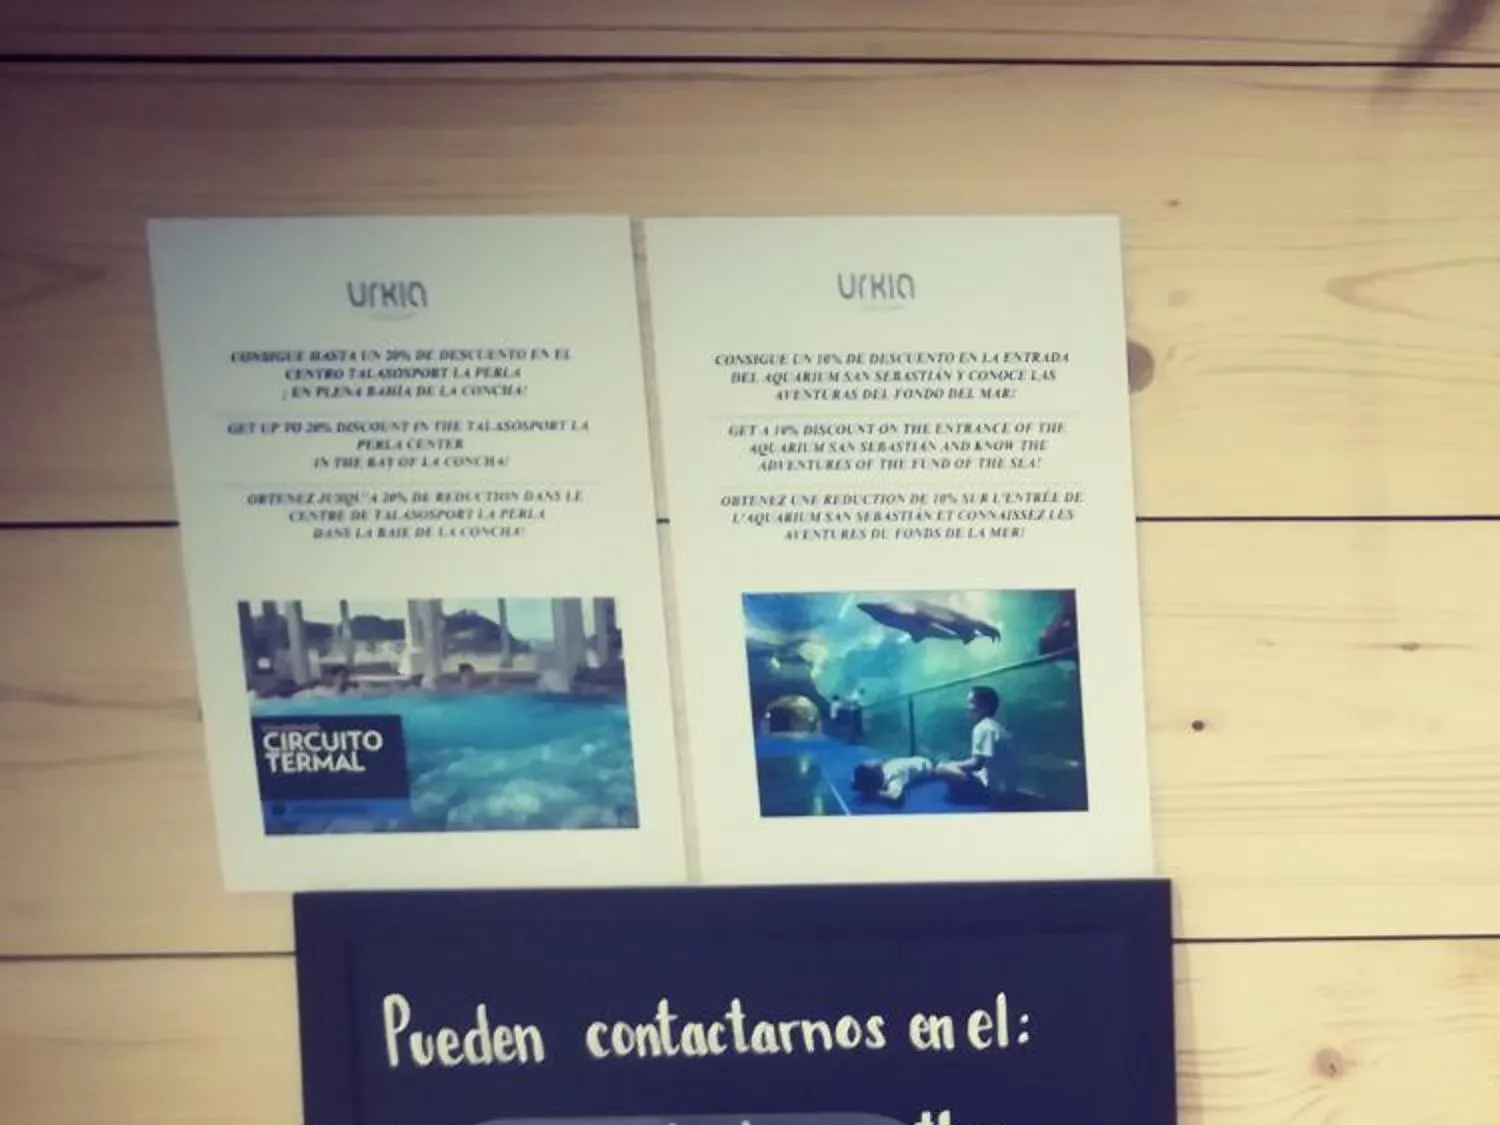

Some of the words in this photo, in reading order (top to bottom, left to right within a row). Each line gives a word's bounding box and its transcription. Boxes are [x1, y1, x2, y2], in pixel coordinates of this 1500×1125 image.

[361, 350, 381, 362] UN
[415, 350, 432, 361] DE
[439, 349, 527, 361] DESCUENTO
[530, 349, 549, 361] EN
[715, 353, 786, 365] CONSIGUE
[792, 353, 812, 365] UN
[817, 353, 842, 365] 10%
[846, 353, 863, 364] DE
[869, 352, 955, 364] DESCUENTO
[959, 352, 977, 363] EN
[981, 352, 999, 363] LA
[1003, 351, 1070, 363] ENTRADA
[284, 368, 345, 380] CENTRO
[453, 367, 471, 379] LA
[475, 367, 522, 379] PERLA
[731, 371, 757, 384] DEL
[765, 371, 839, 386] AQUARIUM
[843, 371, 870, 382] SAN
[967, 369, 1025, 381] CONOCE
[1030, 369, 1057, 381] LAS
[315, 386, 362, 398] PLENA
[416, 386, 434, 398] DE
[439, 385, 457, 397] LA
[776, 388, 858, 401] AVENTURAS
[862, 388, 888, 400] DEL
[894, 388, 945, 400] FONDO
[948, 387, 974, 399] DEL
[227, 422, 256, 434] GET
[261, 422, 280, 434] UP
[284, 421, 303, 433] TO
[336, 420, 409, 433] DISCOUNT
[413, 420, 430, 432] IN
[434, 420, 460, 432] THE
[571, 419, 590, 432] LA
[728, 424, 756, 436] GET
[803, 423, 873, 436] DISCOUNT
[878, 423, 898, 435] ON
[903, 422, 930, 435] THE
[935, 422, 1008, 434] ENTRANCE
[1014, 421, 1032, 434] OF
[1038, 421, 1065, 434] THE
[356, 439, 403, 451] PERLA
[406, 438, 464, 450] CENTER
[751, 441, 825, 457] AQUARIUM
[829, 440, 855, 452] SAN
[943, 439, 971, 451] AND
[974, 439, 1014, 451] KNOW
[1020, 439, 1047, 451] THE
[314, 456, 330, 469] IN
[334, 456, 360, 468] THE
[367, 456, 394, 468] BAY
[397, 456, 417, 468] OF
[421, 456, 439, 467] LA
[760, 458, 851, 471] ADVENTURES
[855, 458, 874, 470] OF
[879, 458, 905, 470] THE
[911, 457, 951, 469] FUND
[954, 457, 973, 469] OF
[978, 457, 1006, 469] THE
[246, 492, 315, 505] OBTENEZ
[412, 491, 430, 503] DE
[523, 490, 561, 502] DANS
[565, 489, 583, 502] LE
[720, 495, 787, 507] OBTENEZ
[791, 494, 818, 506] UNE
[909, 492, 926, 504] DE
[962, 492, 990, 504] SUR
[1064, 491, 1082, 503] DE
[288, 510, 345, 523] CENTRE
[351, 510, 368, 522] DE
[477, 508, 495, 520] LA
[499, 508, 546, 520] PERLA
[825, 511, 851, 523] SAN
[937, 510, 955, 521] ET
[957, 509, 1046, 521] CONNAISSEZ
[1049, 508, 1075, 521] LES
[313, 527, 351, 540] DANS
[355, 527, 373, 539] LA
[377, 527, 409, 539] BAIE
[414, 527, 431, 538] DE
[438, 527, 455, 538] LA
[785, 528, 867, 541] AVENTURES
[894, 527, 942, 540] FONDS
[945, 527, 963, 539] DE
[967, 527, 985, 539] LA
[262, 730, 384, 752] CIRCUITO
[265, 750, 366, 773] TERMAL
[383, 992, 546, 1068] Pueden
[585, 997, 888, 1059] contactarnos
[908, 1012, 956, 1051] en
